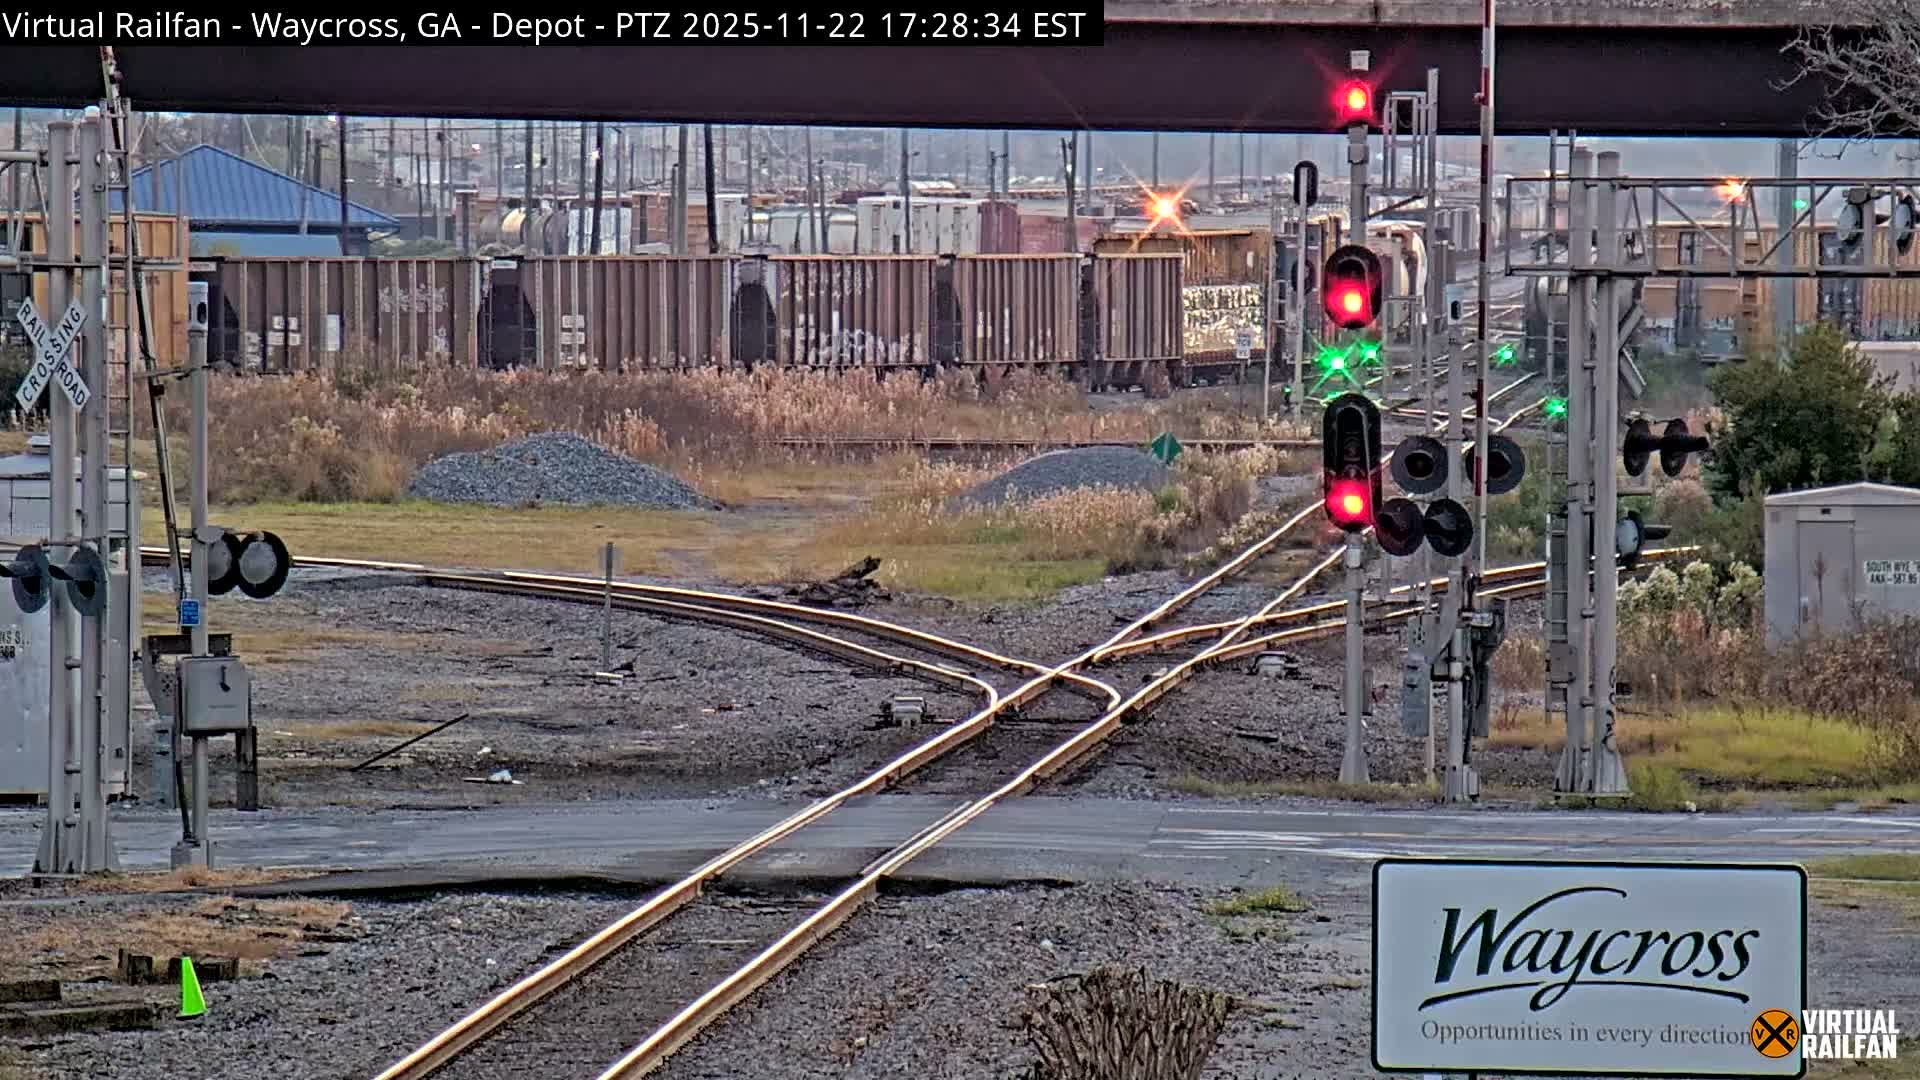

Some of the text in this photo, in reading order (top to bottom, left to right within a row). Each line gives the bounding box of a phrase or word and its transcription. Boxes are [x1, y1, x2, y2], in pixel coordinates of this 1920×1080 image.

[20, 303, 86, 406] RAIL ROAD
[22, 307, 81, 402] CROSSING
[1434, 887, 1760, 1012] Waycross
[1421, 1020, 1752, 1048] Opportunities in every direction
